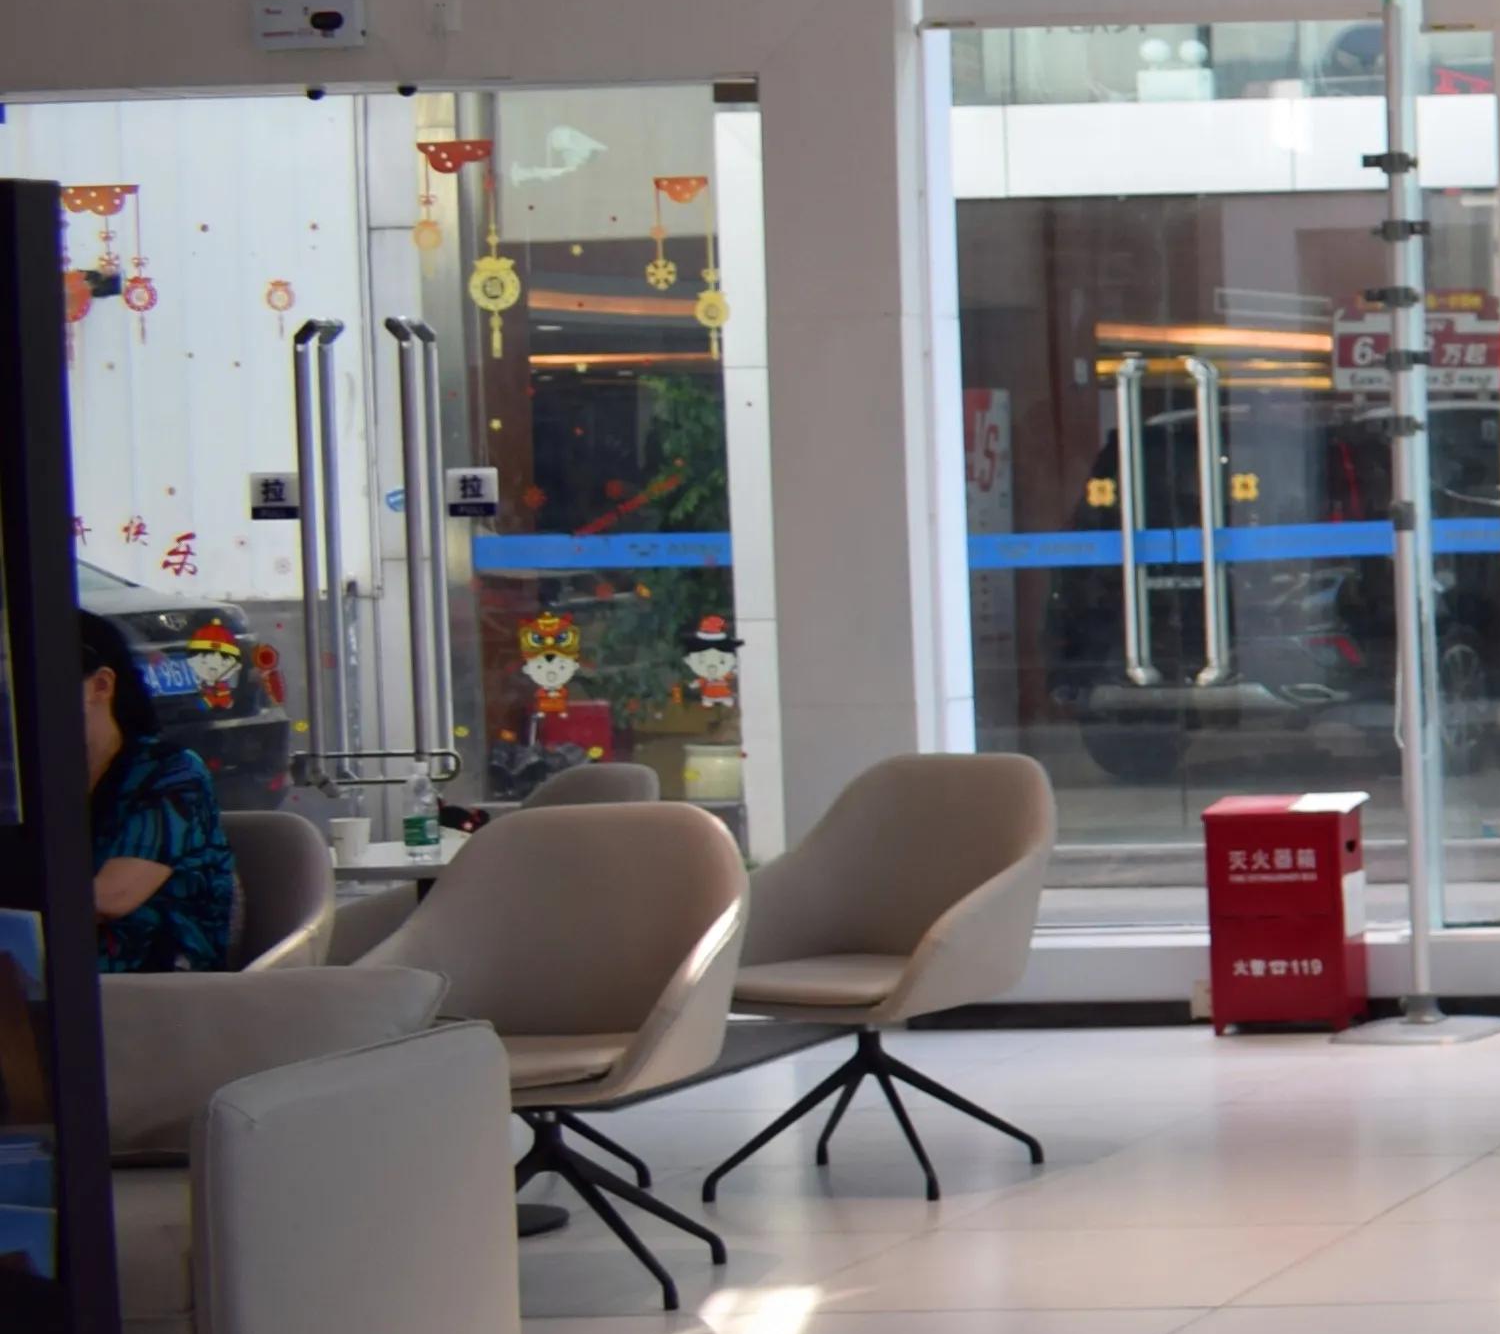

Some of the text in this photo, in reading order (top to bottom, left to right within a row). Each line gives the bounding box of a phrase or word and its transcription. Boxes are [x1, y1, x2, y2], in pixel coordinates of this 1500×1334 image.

[261, 478, 286, 503] 拉
[459, 474, 484, 499] 拉
[1290, 958, 1323, 976] 119
